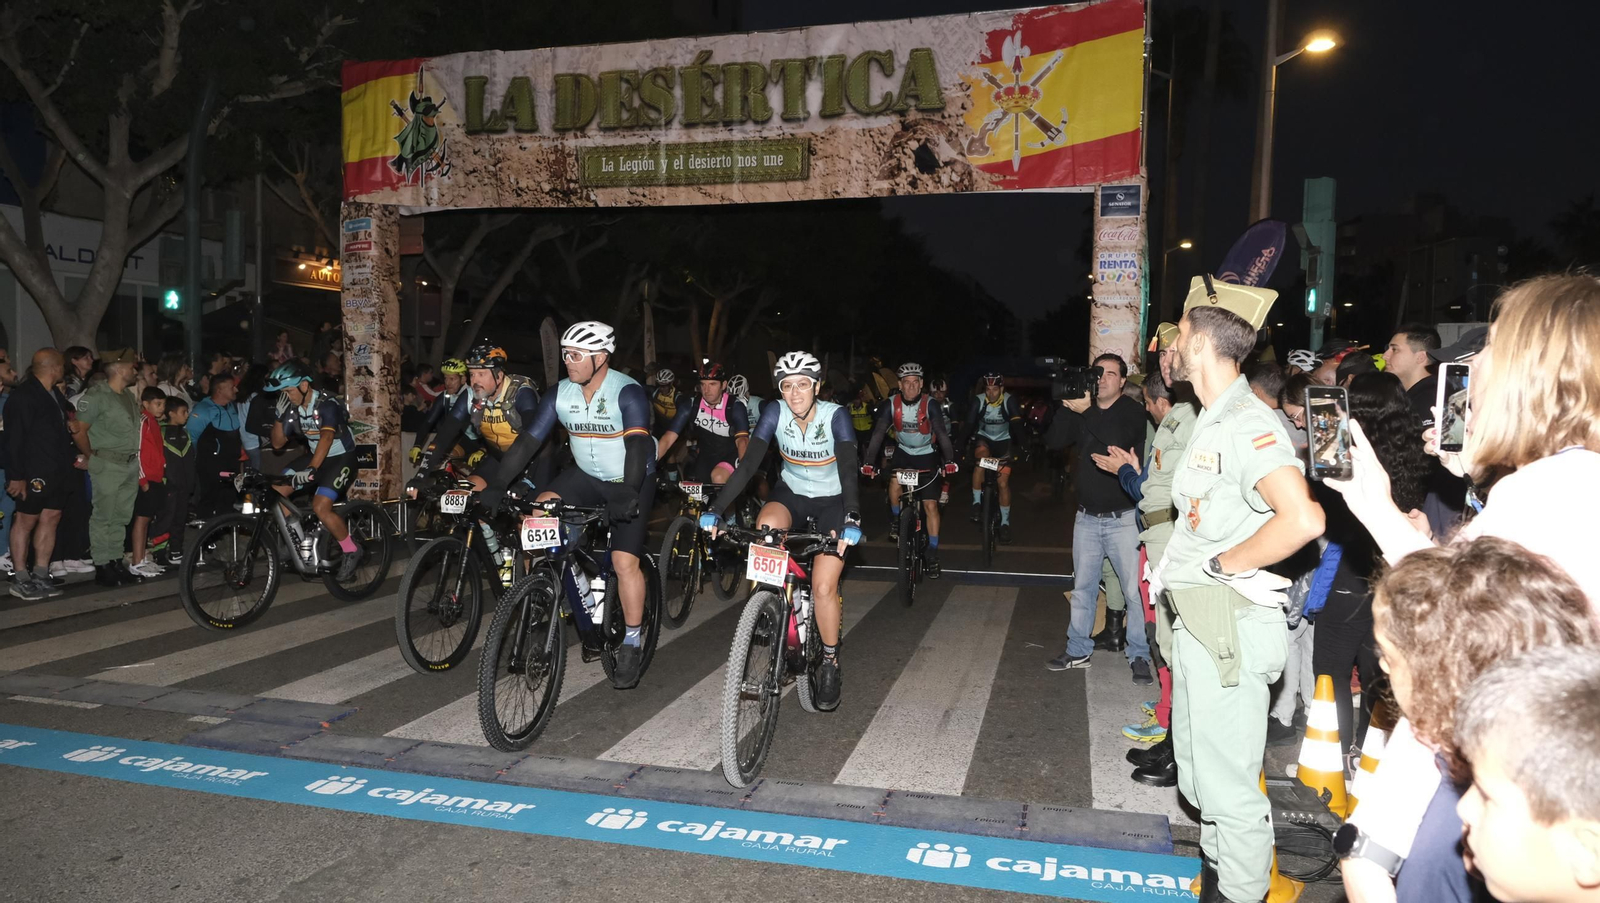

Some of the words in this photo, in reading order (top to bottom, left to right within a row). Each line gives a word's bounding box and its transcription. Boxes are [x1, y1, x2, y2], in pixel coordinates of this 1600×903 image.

[463, 75, 539, 135] LA
[552, 47, 946, 133] DESÉRTICA
[601, 156, 614, 173] La
[618, 154, 655, 174] Legión
[660, 160, 667, 174] y
[673, 154, 684, 171] el
[689, 153, 732, 171] desierto
[737, 156, 757, 169] nos
[763, 153, 784, 168] une
[1098, 228, 1138, 241] Coca-Cola
[46, 244, 144, 269] ALDT
[1099, 260, 1137, 269] RENTA
[310, 269, 340, 283] AUTO
[346, 299, 371, 308] BBVA
[565, 422, 573, 431] LA
[574, 421, 616, 433] DESÉRTICA
[782, 444, 789, 454] LA
[791, 449, 830, 459] DESÉRTICA
[900, 472, 917, 480] 7593
[444, 495, 465, 506] 8883
[527, 528, 557, 543] 6512
[753, 556, 783, 575] 6501
[118, 755, 269, 781] cajamar
[171, 772, 201, 782] CAJA
[203, 776, 243, 787] RURAL
[367, 786, 535, 815] cajamar
[434, 805, 470, 816] CAJA
[472, 809, 516, 821] RURAL
[656, 820, 849, 850] cajamar
[742, 841, 775, 851] CAJA
[777, 844, 835, 859] RURAL
[986, 857, 1197, 892] cajamar
[1091, 880, 1136, 893] CAJA
[1142, 885, 1199, 900] RURAL
